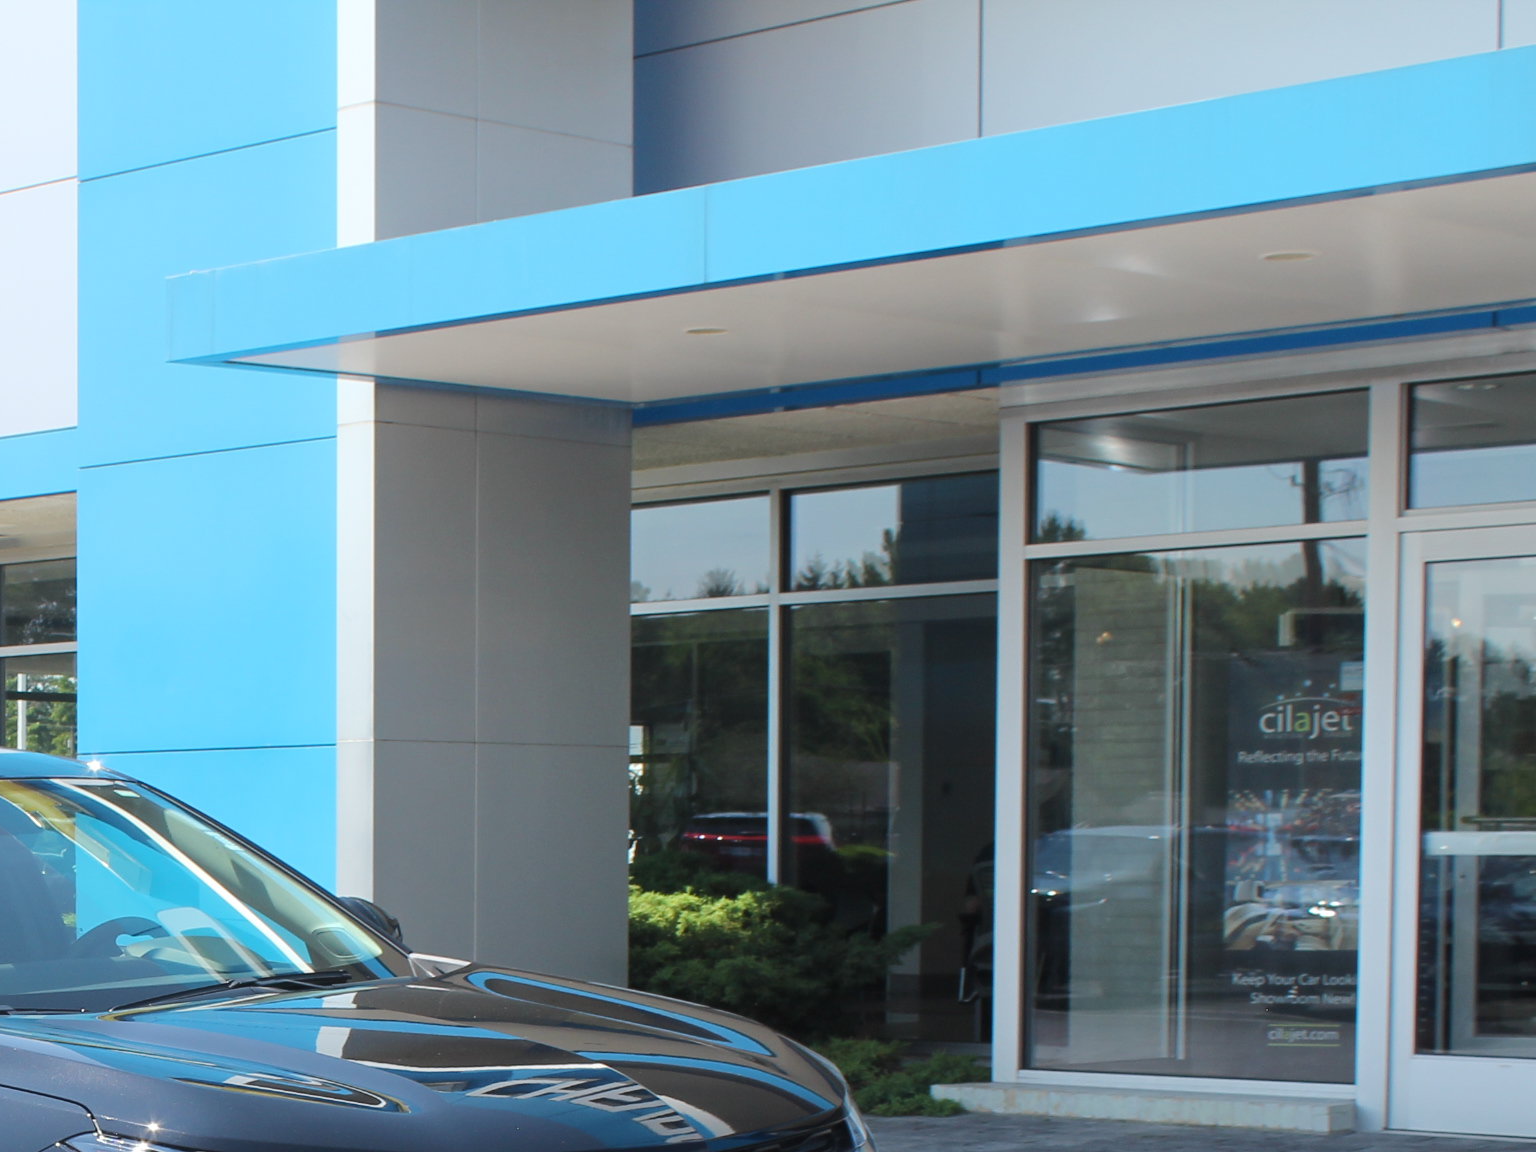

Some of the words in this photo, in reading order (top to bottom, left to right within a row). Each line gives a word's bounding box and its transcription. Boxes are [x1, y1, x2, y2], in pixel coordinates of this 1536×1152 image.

[1306, 750, 1329, 761] the
[1231, 973, 1265, 987] Keep
[1266, 973, 1295, 985] Your
[1297, 973, 1320, 985] Car
[1267, 1028, 1339, 1042] cilajet.com
